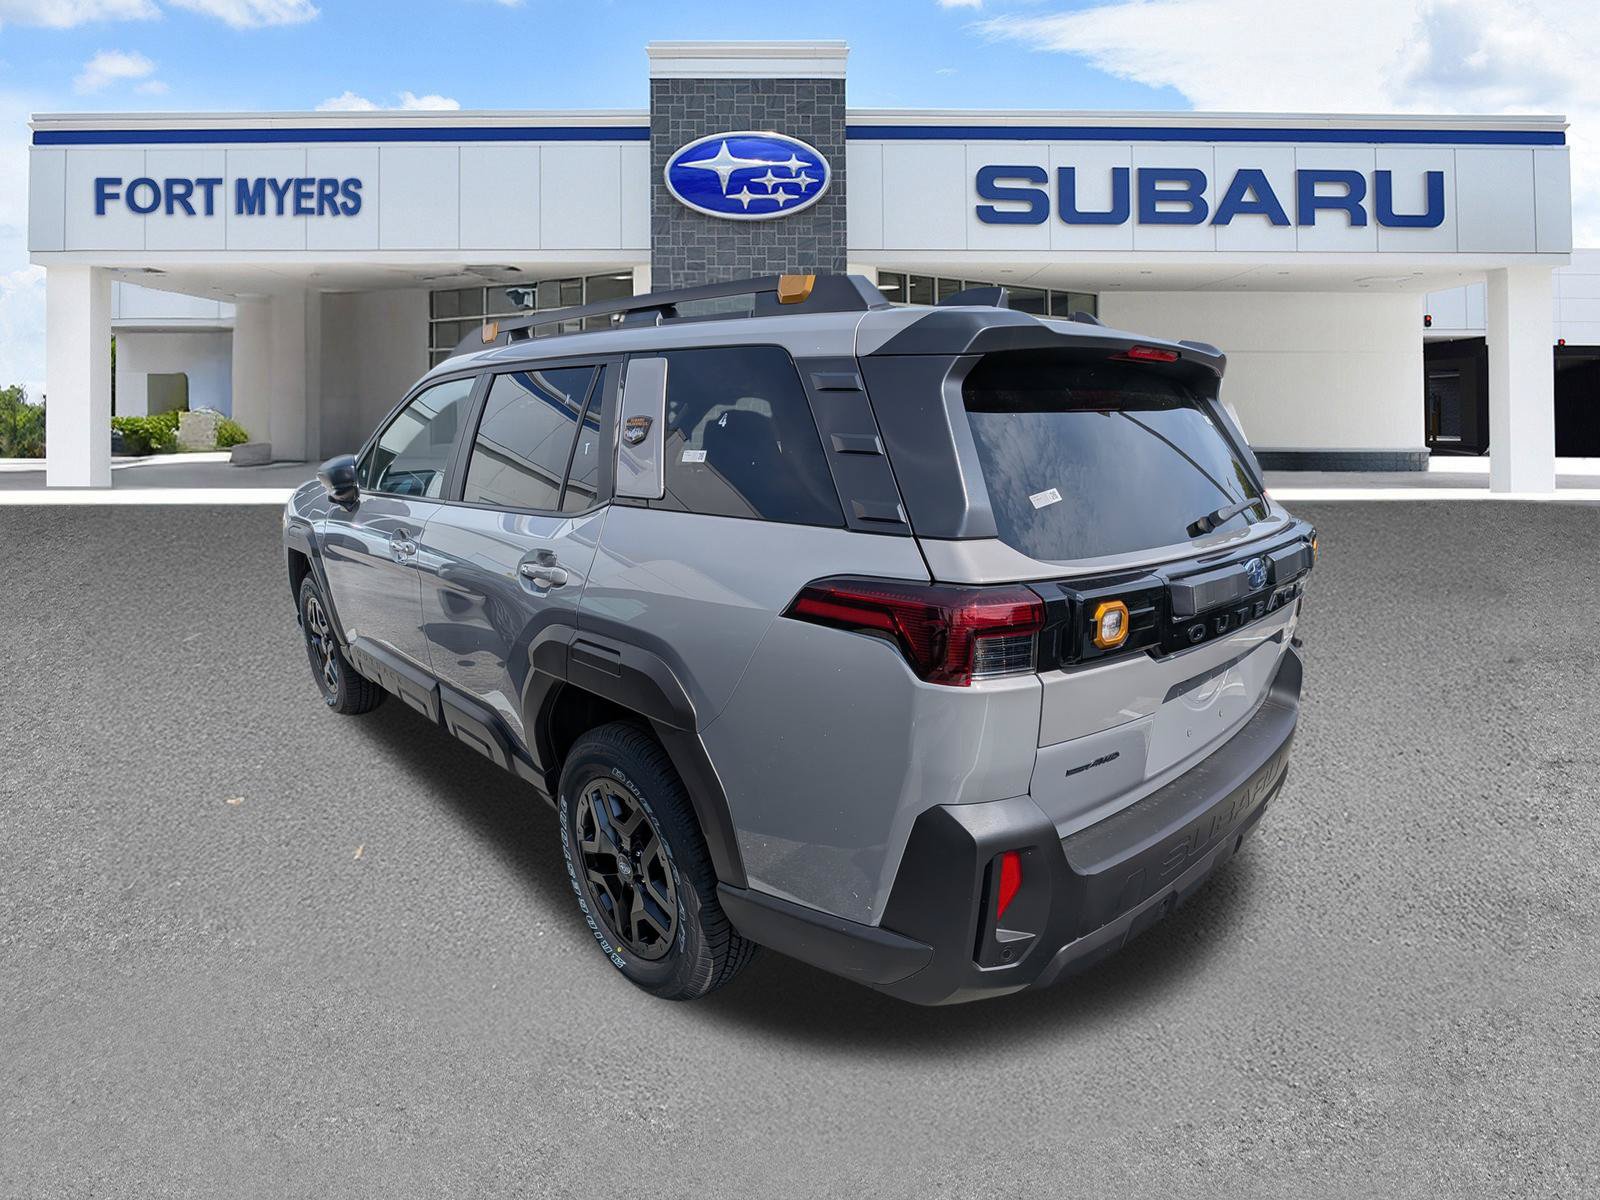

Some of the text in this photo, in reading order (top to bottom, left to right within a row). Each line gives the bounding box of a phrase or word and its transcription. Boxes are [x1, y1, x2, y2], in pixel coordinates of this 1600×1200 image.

[94, 177, 363, 216] FORT MYERS
[975, 165, 1445, 228] SUBARU
